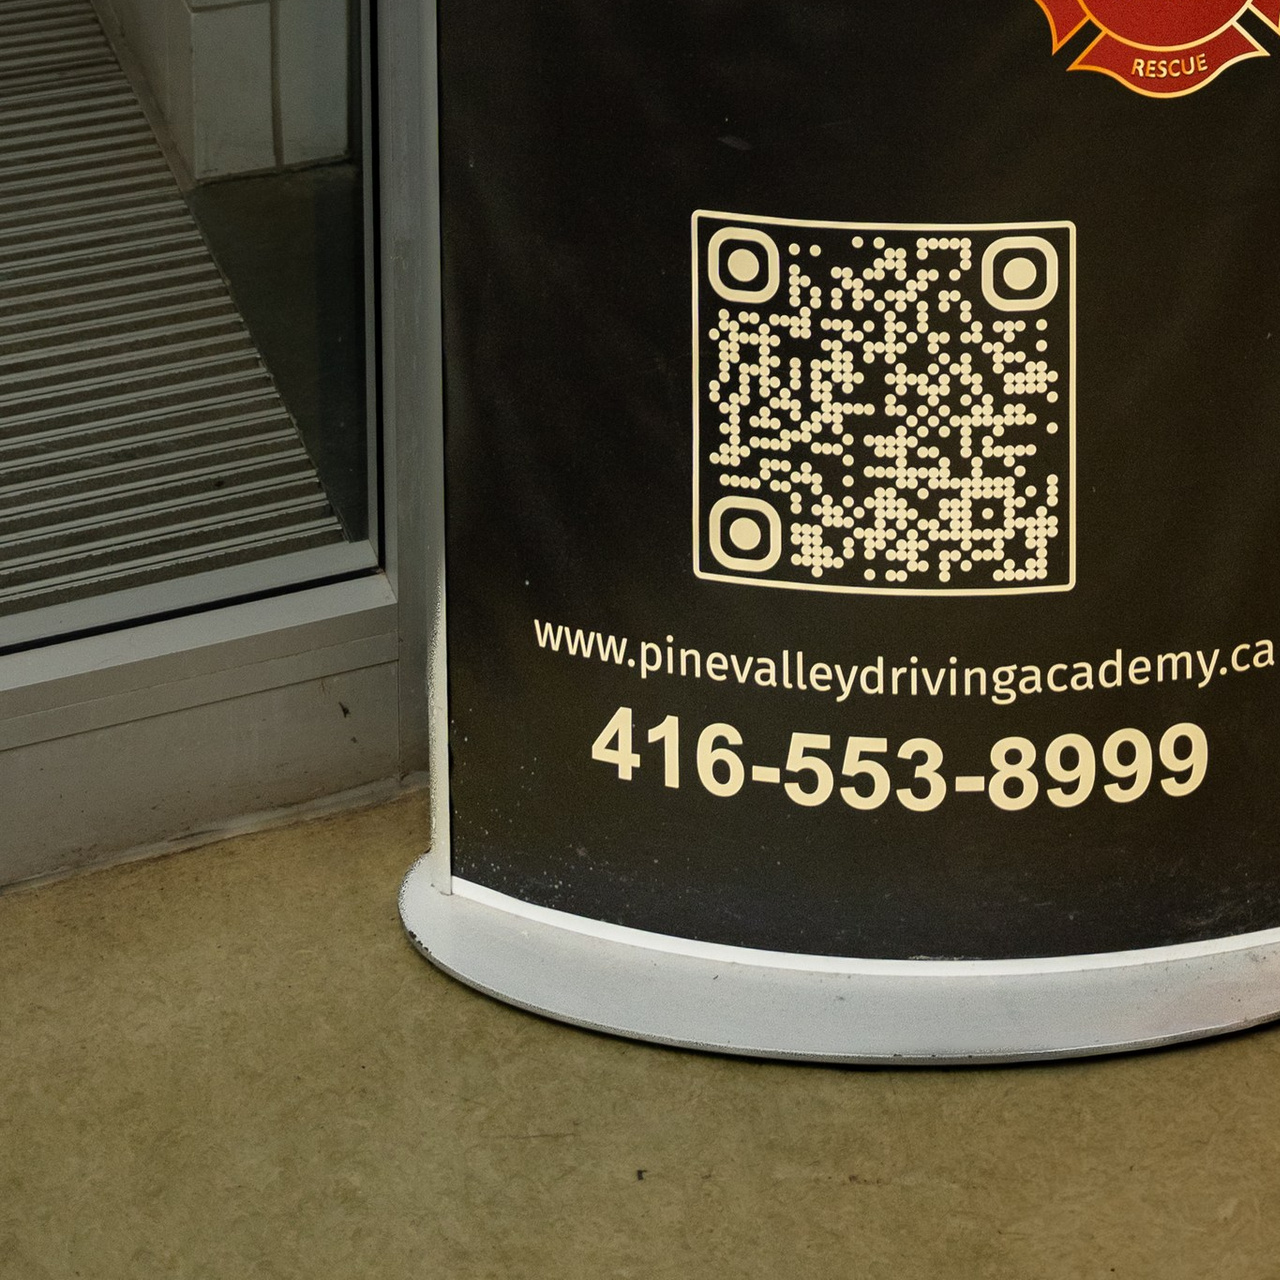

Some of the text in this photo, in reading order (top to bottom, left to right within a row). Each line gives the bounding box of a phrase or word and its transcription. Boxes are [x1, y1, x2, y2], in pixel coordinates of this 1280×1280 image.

[1131, 53, 1208, 78] RESCUE
[533, 618, 1275, 704] www.pinevalleydrivingacademy.ca
[591, 706, 1209, 812] 416-553-8999
